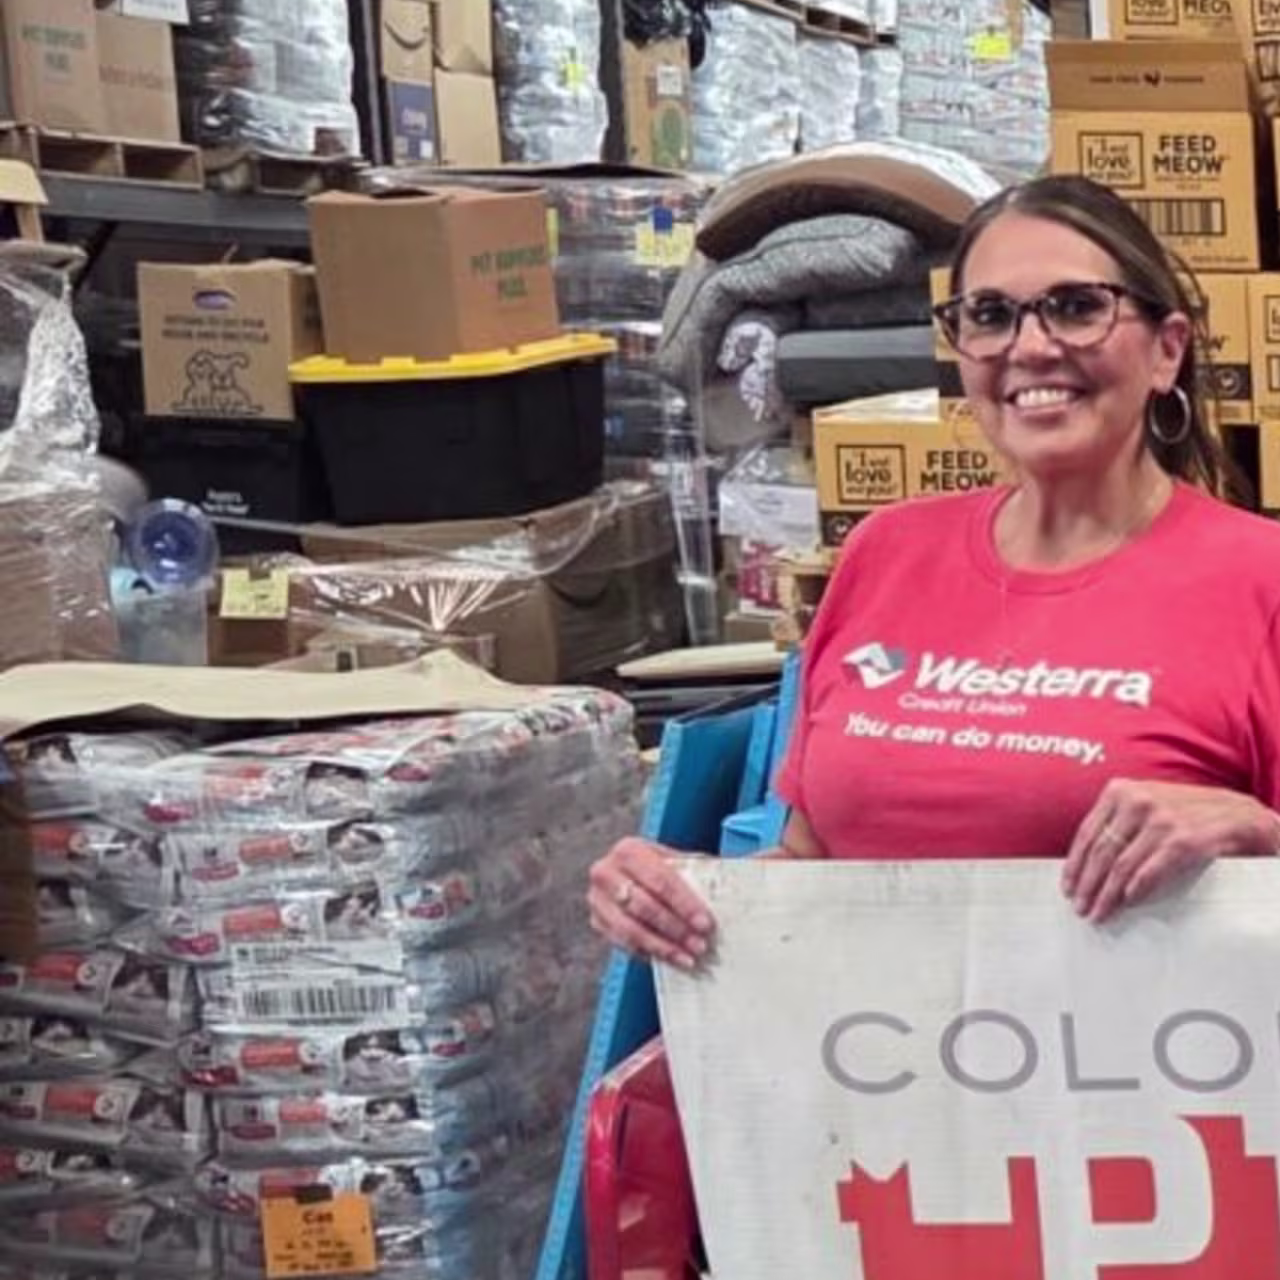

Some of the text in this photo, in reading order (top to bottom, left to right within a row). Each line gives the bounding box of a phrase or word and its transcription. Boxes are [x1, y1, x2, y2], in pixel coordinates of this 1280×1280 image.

[1159, 134, 1216, 153] FEED
[1153, 154, 1223, 173] MEOW
[926, 450, 989, 470] FEED
[845, 460, 892, 483] love
[920, 471, 995, 492] MEOW
[916, 652, 1153, 707] Westerra
[898, 693, 1028, 717] Credit Union
[845, 713, 1106, 764] You can do money.
